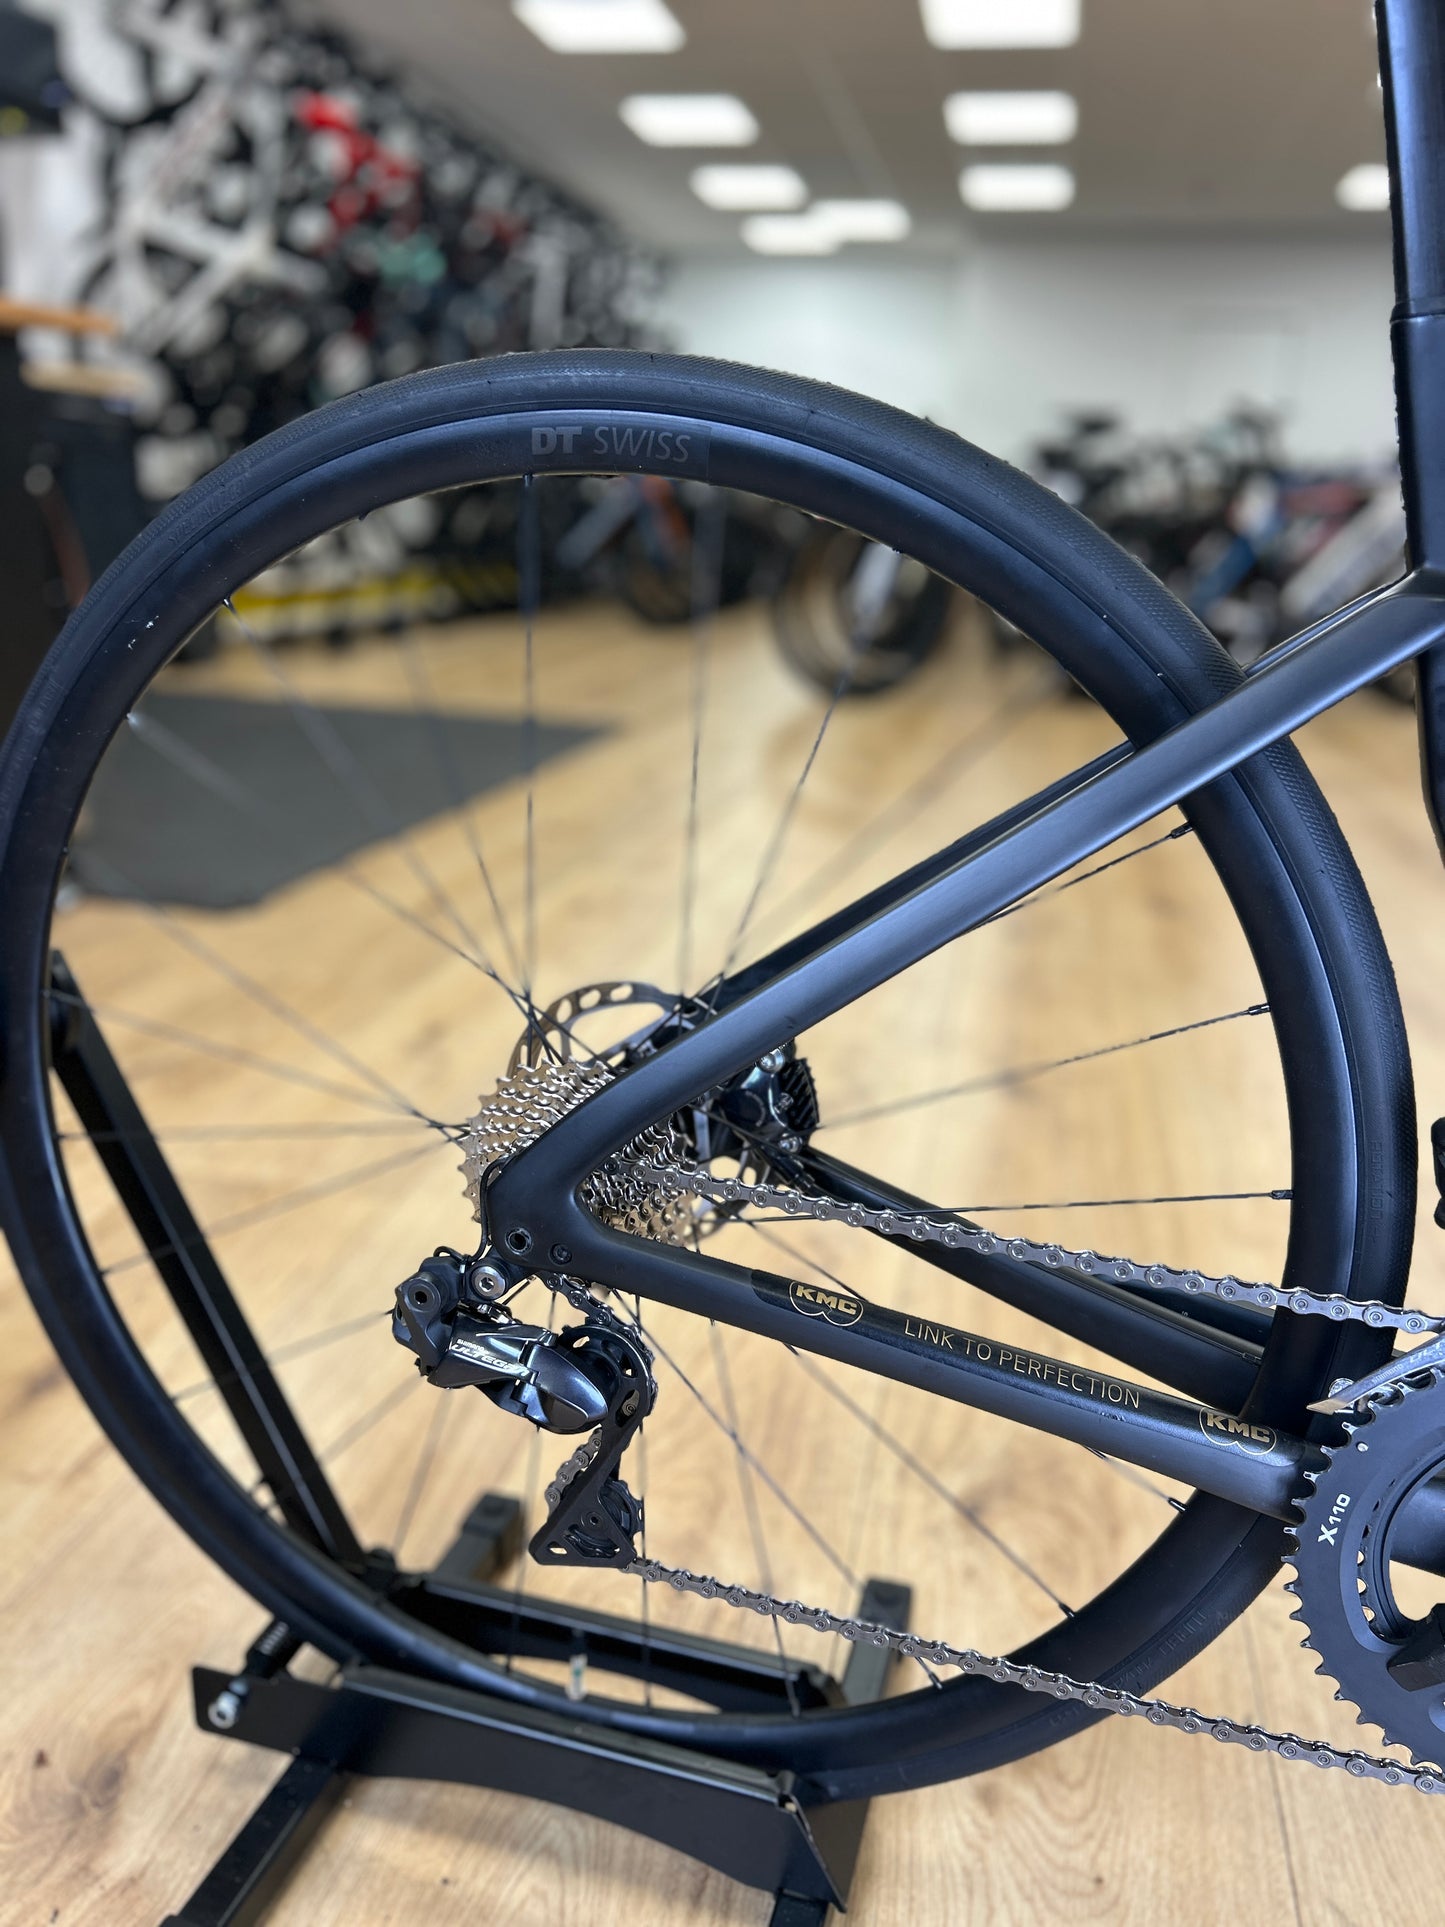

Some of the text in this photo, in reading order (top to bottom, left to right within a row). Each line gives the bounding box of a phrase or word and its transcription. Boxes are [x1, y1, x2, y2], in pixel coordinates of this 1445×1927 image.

[531, 426, 692, 463] DT SWISS
[795, 1284, 858, 1316] KMC
[904, 1319, 1140, 1410] LINK TO PERFECTION
[1205, 1411, 1270, 1443] KMC
